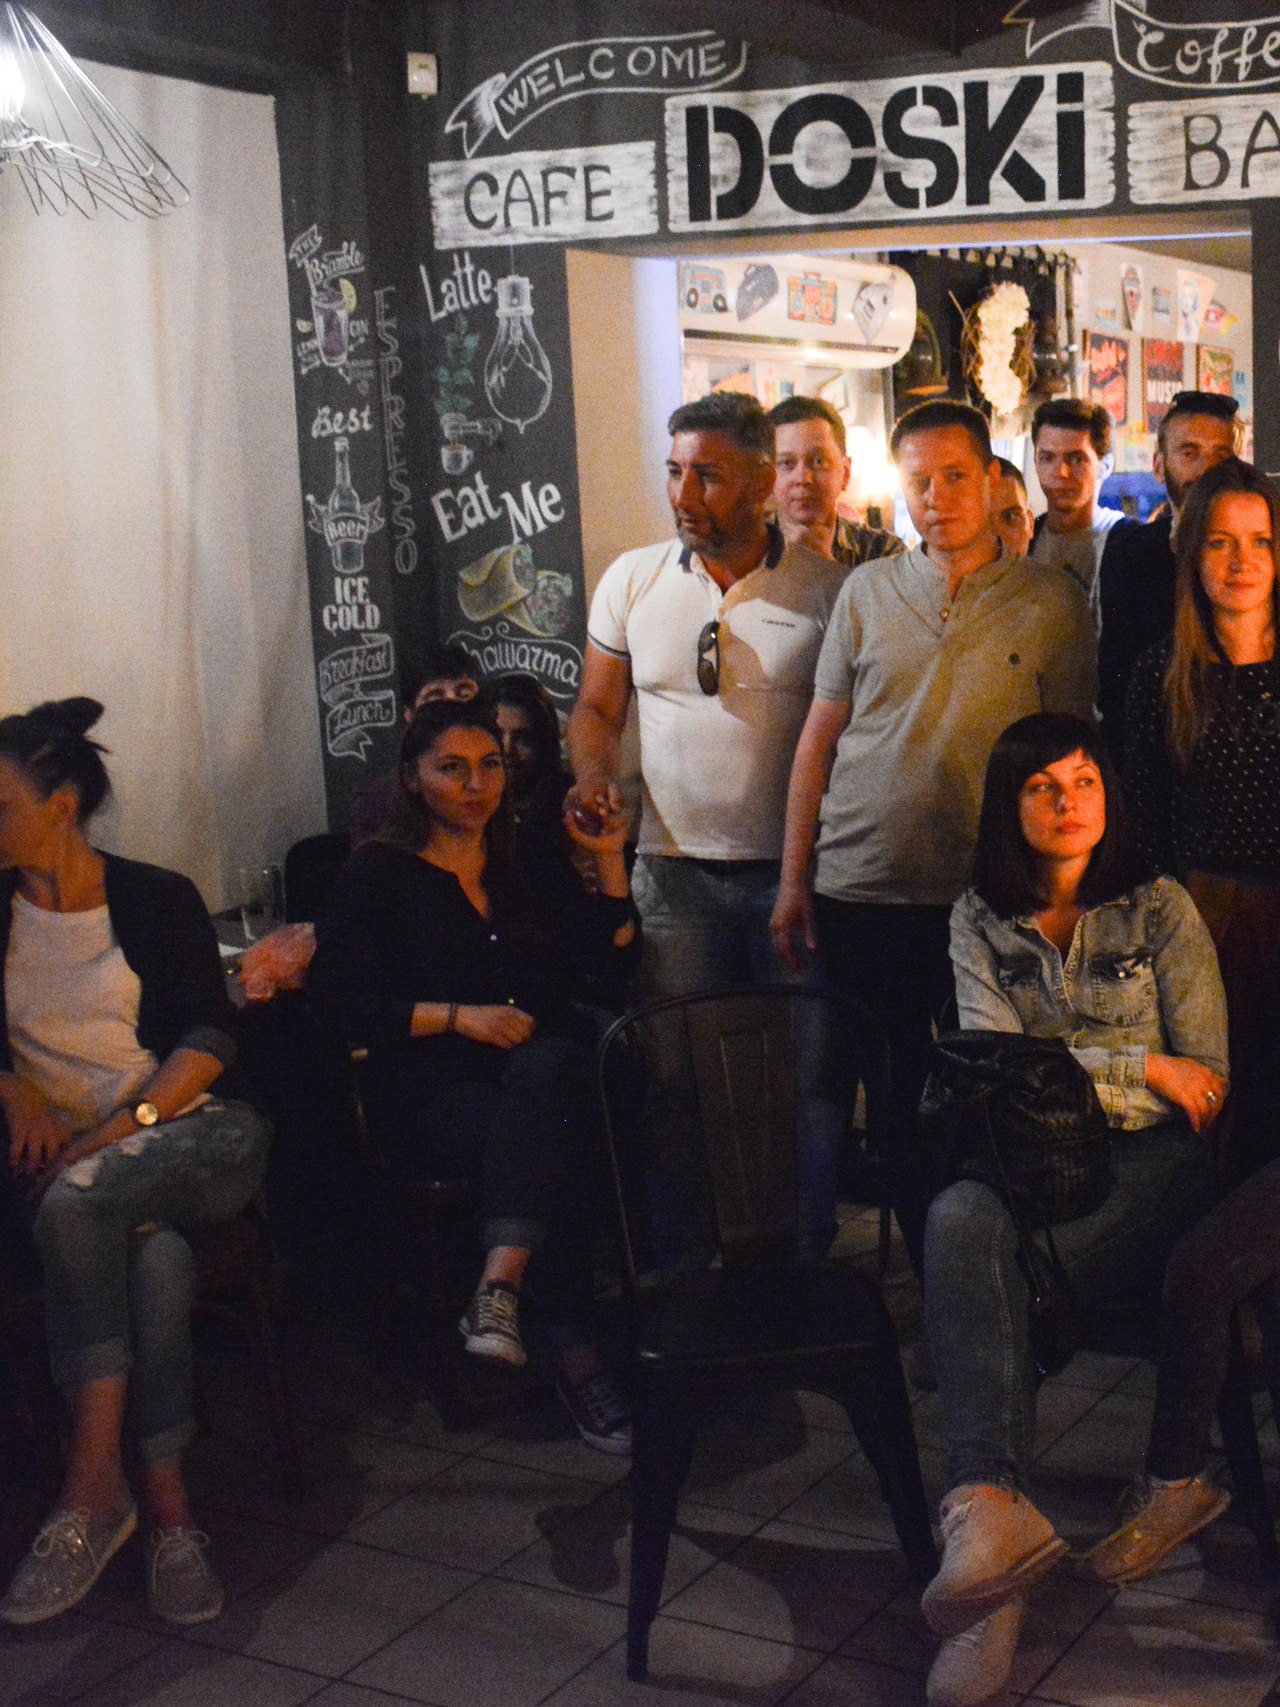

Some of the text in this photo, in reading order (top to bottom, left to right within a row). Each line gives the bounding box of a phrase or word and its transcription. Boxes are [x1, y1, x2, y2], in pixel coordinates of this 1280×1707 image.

[500, 39, 726, 116] WELCOME
[464, 165, 615, 230] CAFE
[420, 252, 492, 322] Latte
[311, 404, 373, 439] Best
[431, 471, 565, 545] Eat Me
[335, 577, 370, 604] ICE
[322, 604, 380, 635] COLD
[461, 641, 579, 687] hawarma
